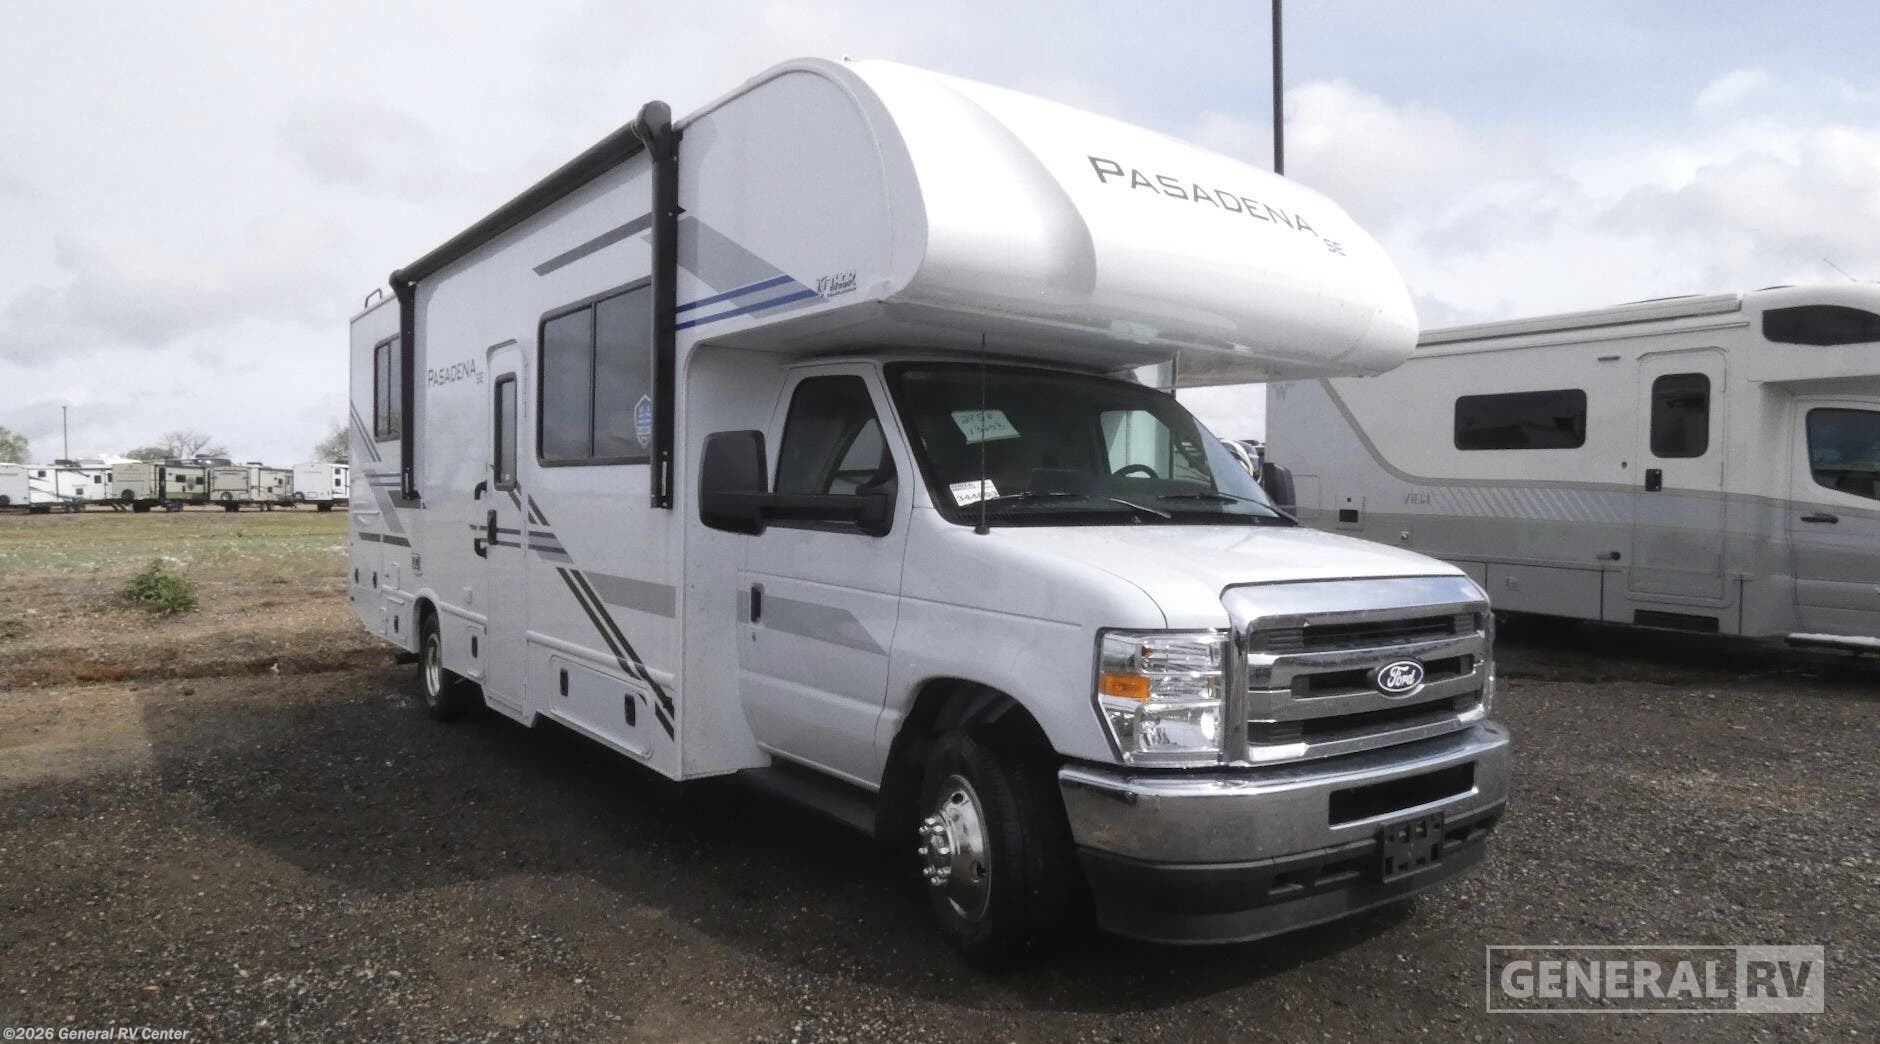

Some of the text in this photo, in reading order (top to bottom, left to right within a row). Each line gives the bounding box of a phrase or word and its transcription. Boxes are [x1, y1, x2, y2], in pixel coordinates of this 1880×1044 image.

[1088, 155, 1318, 237] PASADENA
[427, 358, 476, 389] PASADENA
[1387, 665, 1416, 688] Ford
